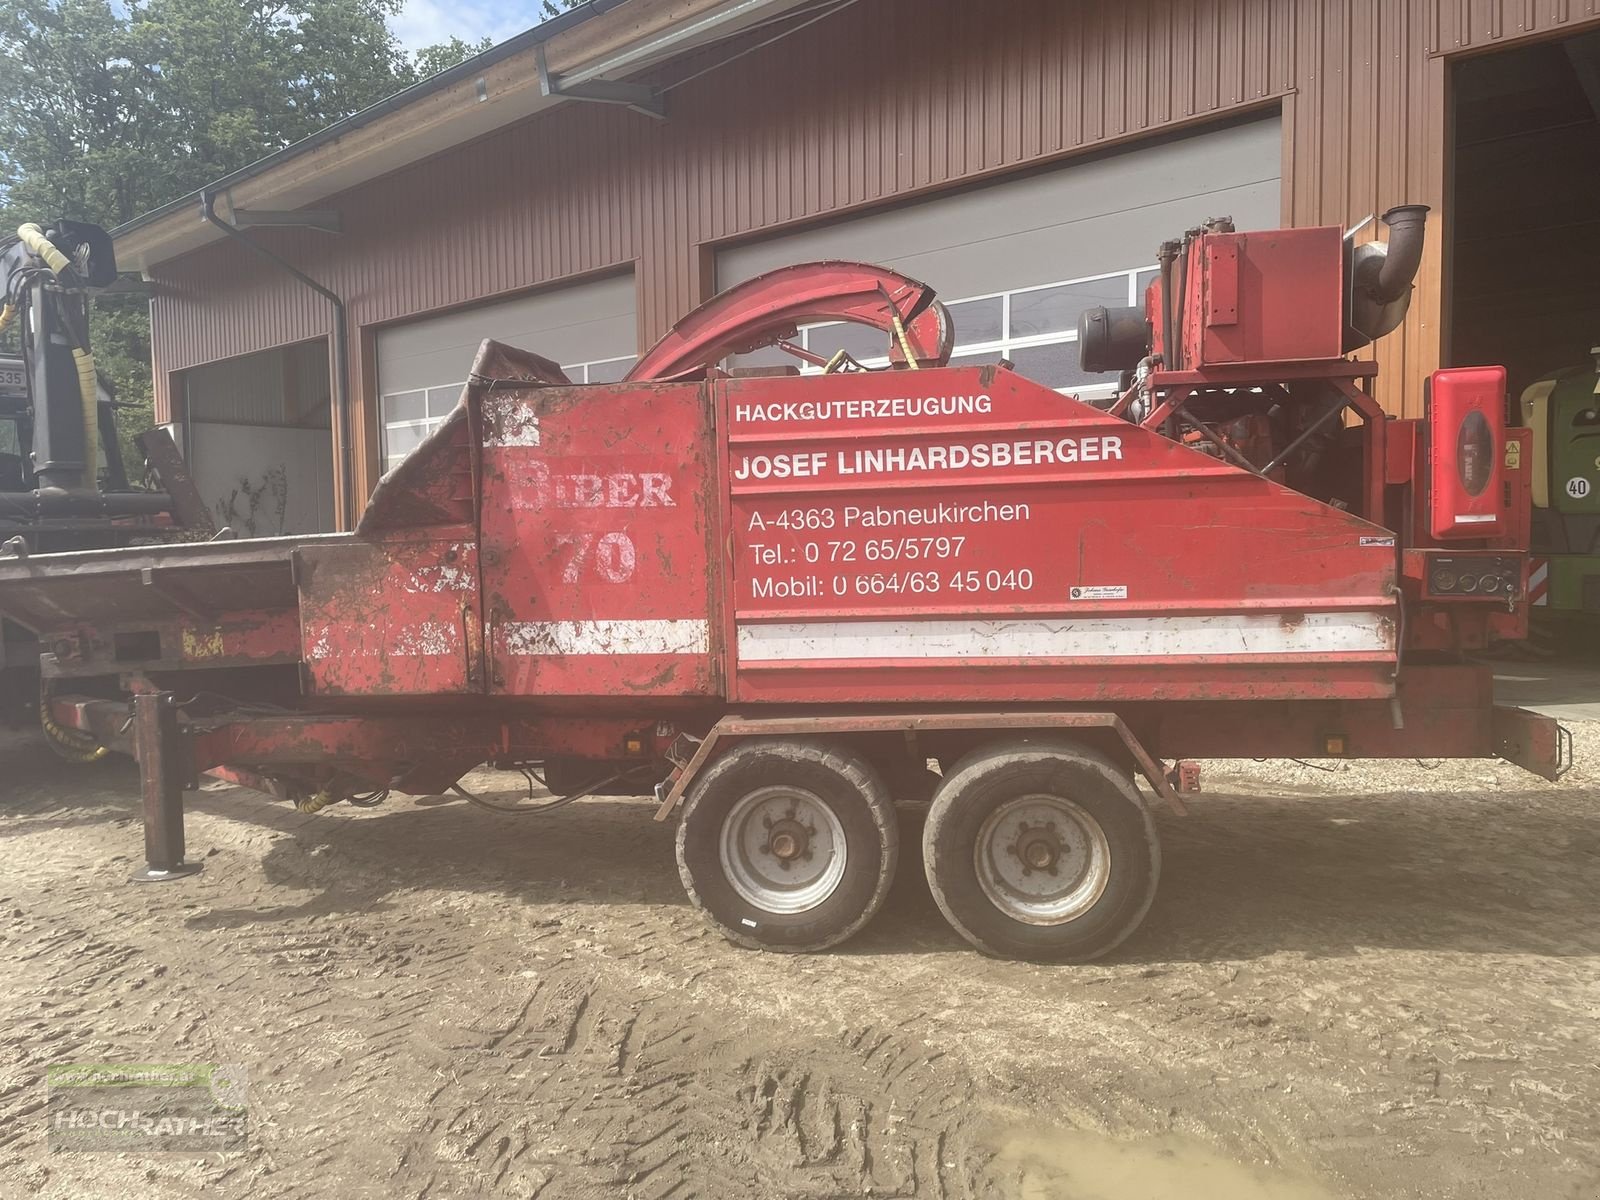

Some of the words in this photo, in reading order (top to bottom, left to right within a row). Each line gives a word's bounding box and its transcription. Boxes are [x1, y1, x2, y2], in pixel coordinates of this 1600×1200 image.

[735, 394, 993, 423] HACKGUTERZEUGUNG
[734, 451, 828, 481] JOSEF
[838, 435, 1123, 475] LINHARDSBERGER
[1569, 480, 1586, 495] 40
[748, 508, 836, 532] A-4363
[844, 501, 1031, 529] Pabneukirchen
[555, 531, 636, 584] 70
[749, 543, 797, 566] Tel.:
[804, 542, 820, 563] 0
[828, 540, 857, 562] 72
[865, 535, 967, 561] 65/5797
[752, 574, 824, 599] Mobil:
[832, 575, 848, 596] 0
[855, 571, 940, 596] 664/63
